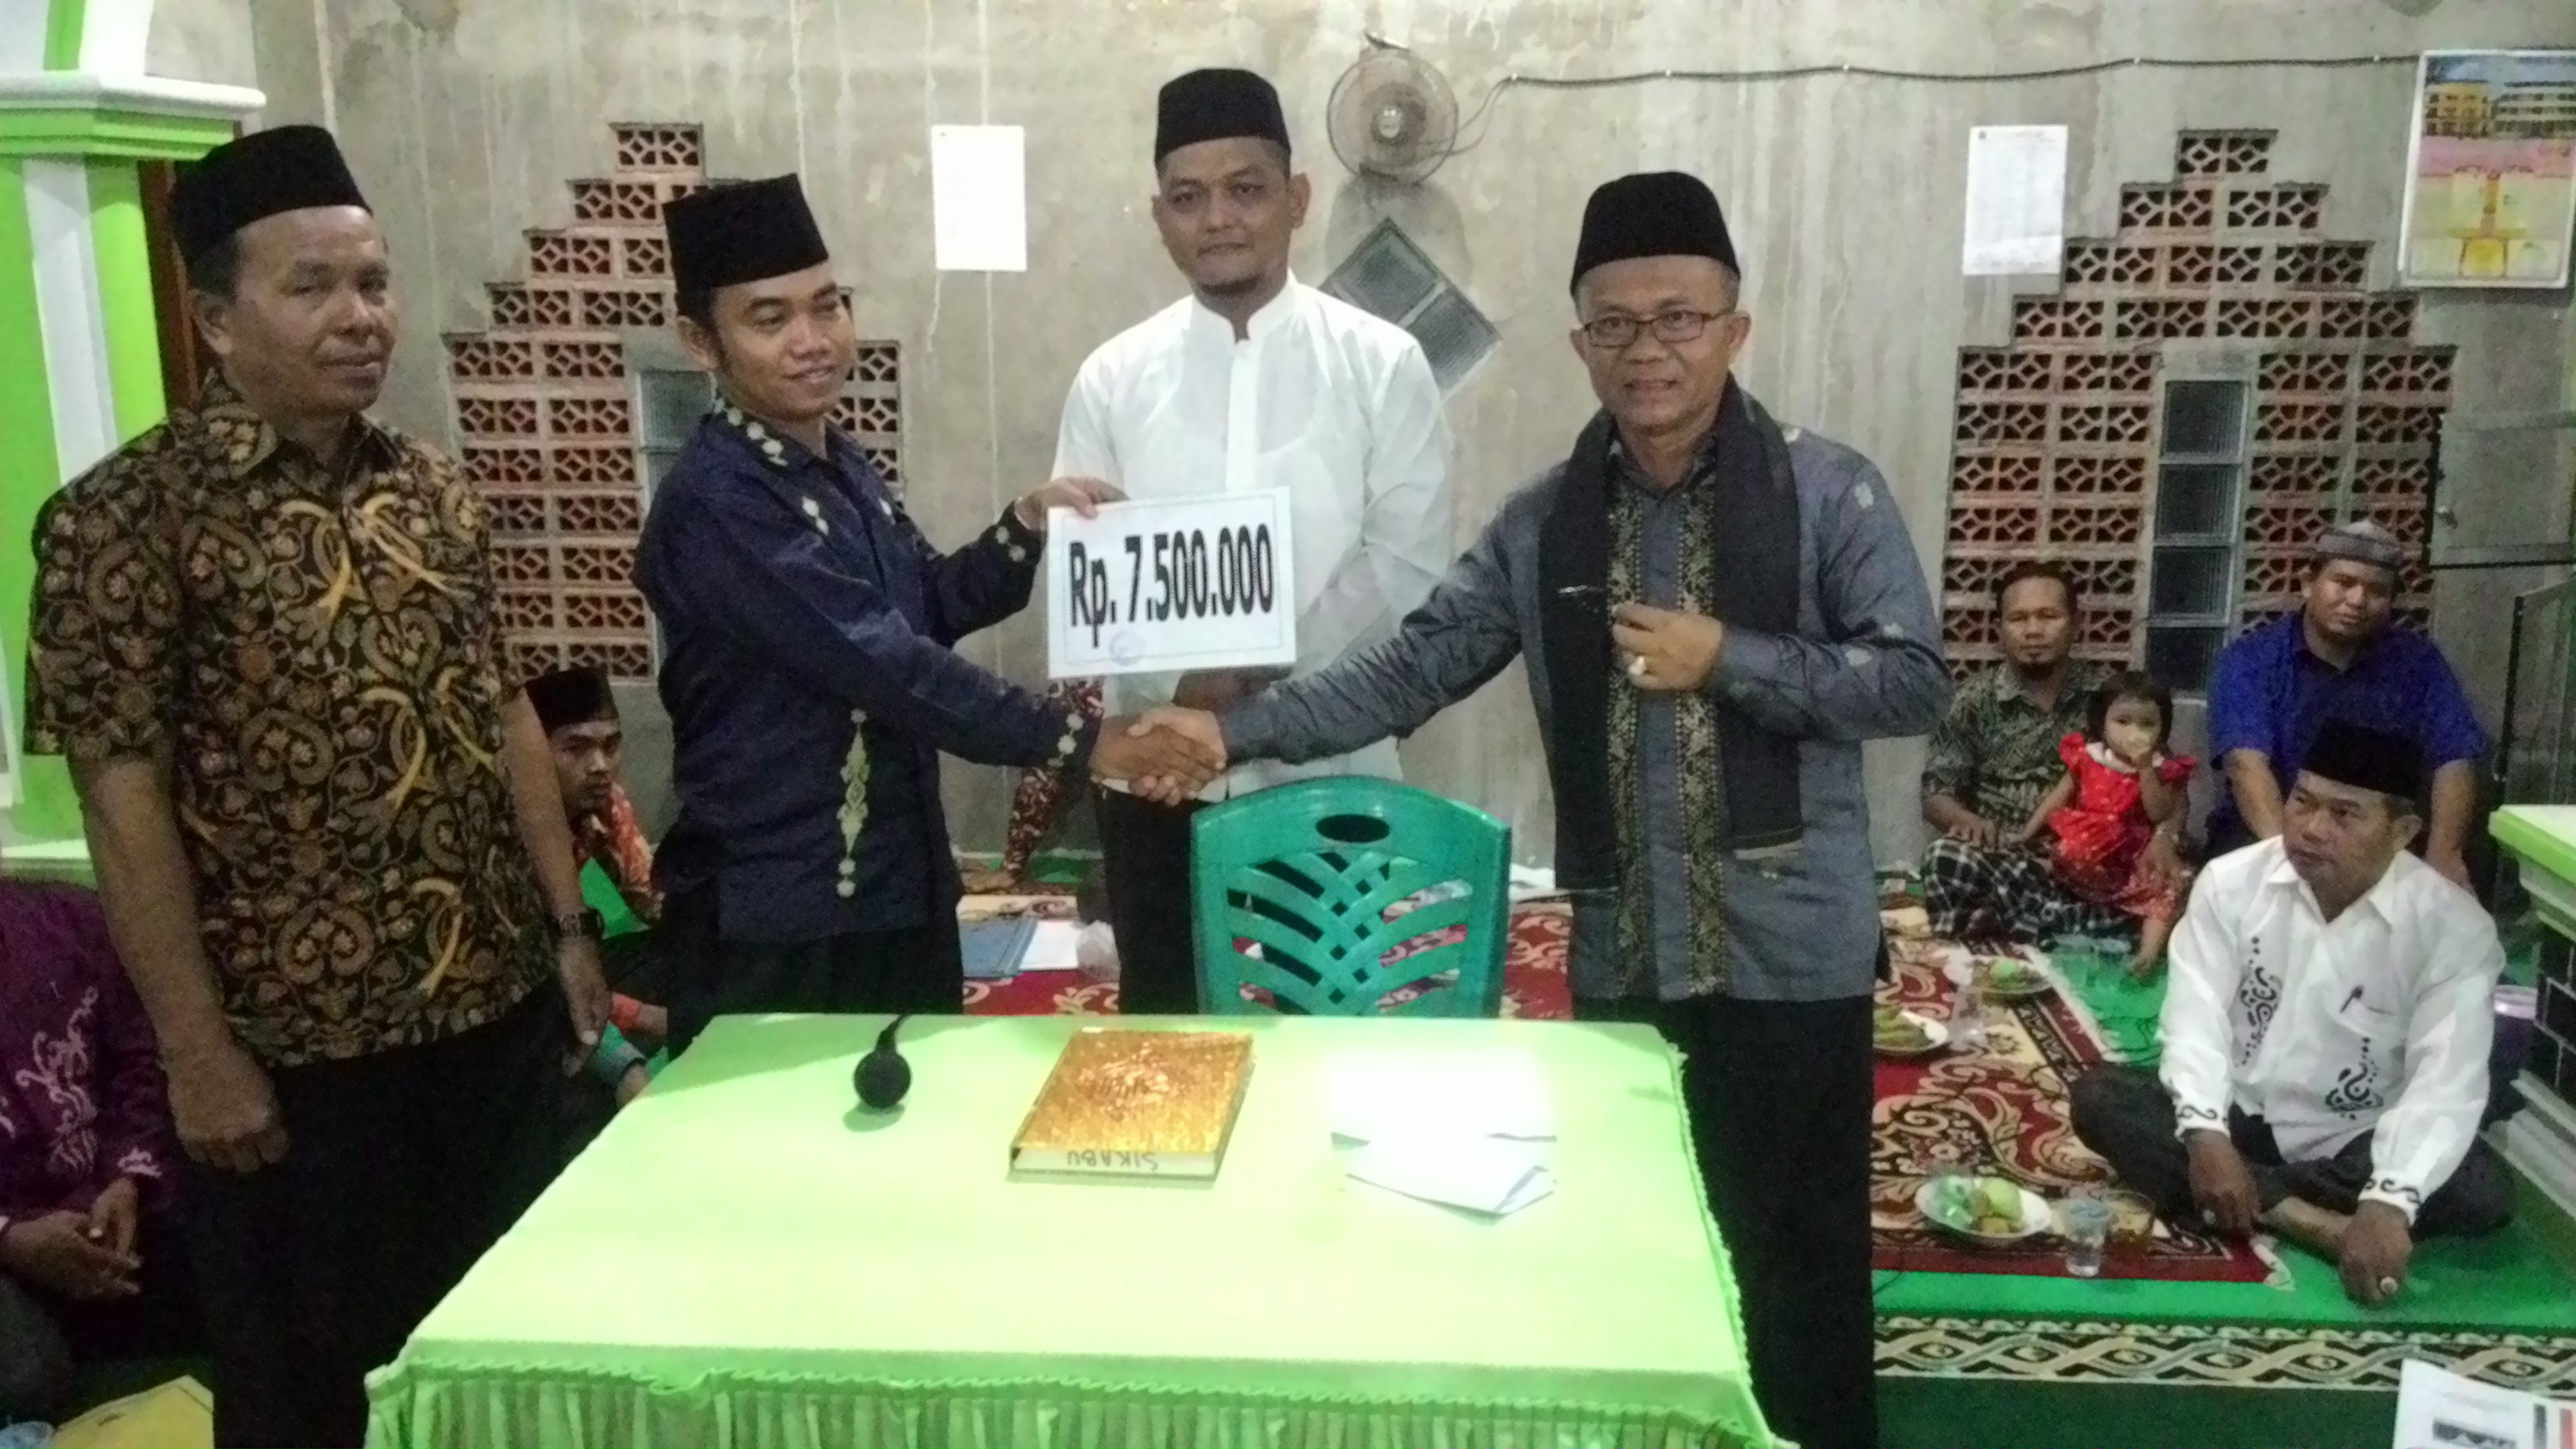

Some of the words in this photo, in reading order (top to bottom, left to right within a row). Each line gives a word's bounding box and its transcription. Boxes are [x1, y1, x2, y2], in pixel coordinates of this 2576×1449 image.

[1069, 540, 1117, 649] Rp.
[1125, 523, 1273, 621] 7.500.000
[1066, 1149, 1159, 1170] SIKABU
